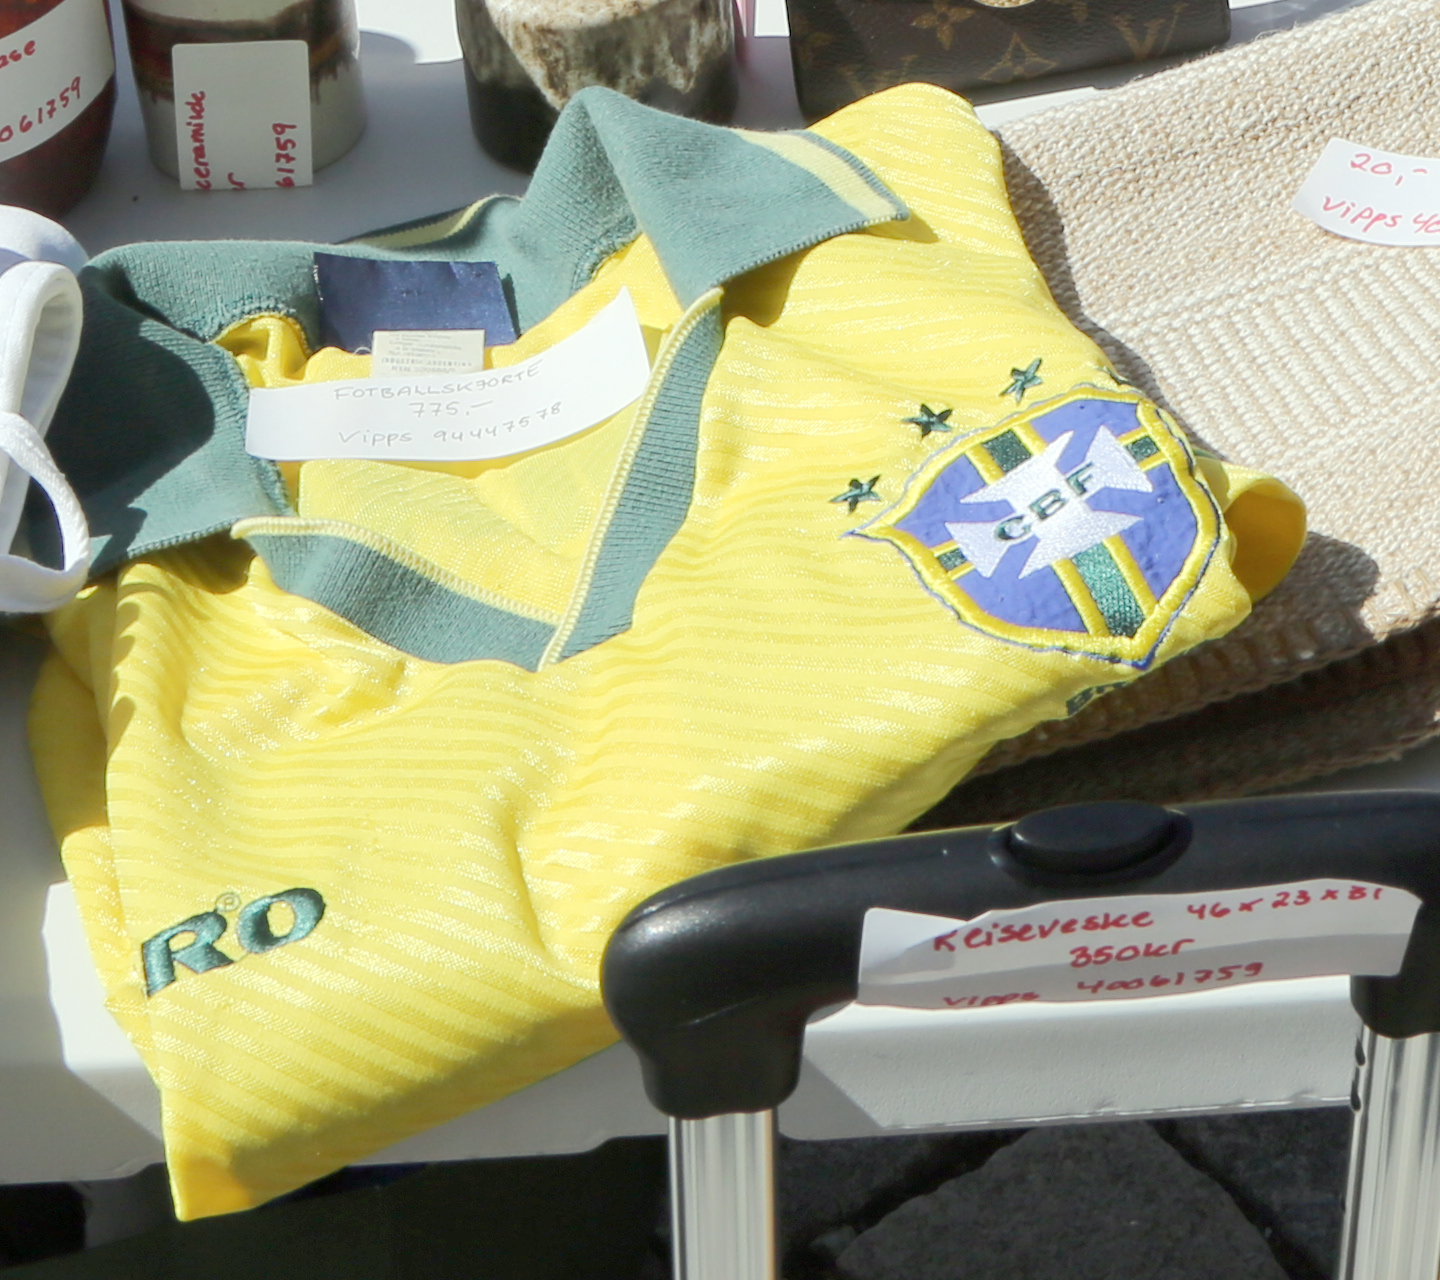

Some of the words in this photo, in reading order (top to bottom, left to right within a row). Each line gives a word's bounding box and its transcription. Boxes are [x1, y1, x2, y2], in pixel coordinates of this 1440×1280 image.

[992, 461, 1096, 544] CBF
[1186, 901, 1231, 920] 46
[1271, 889, 1312, 909] 23
[1076, 960, 1265, 993] 40061759
